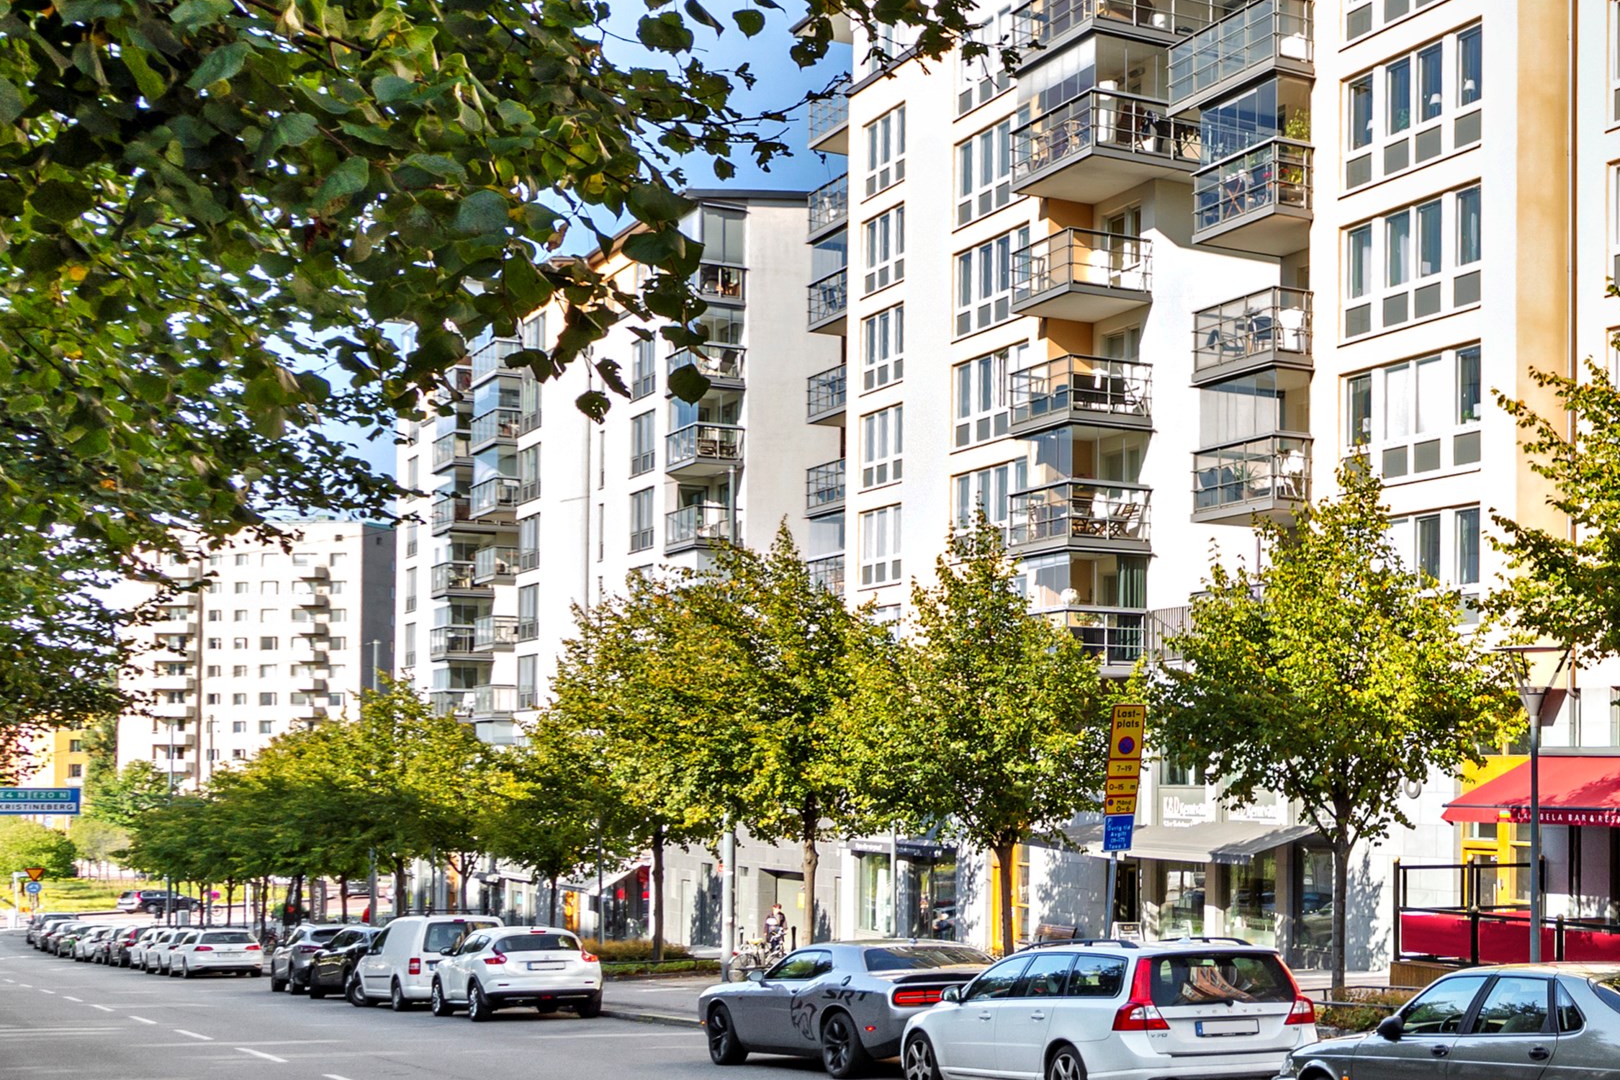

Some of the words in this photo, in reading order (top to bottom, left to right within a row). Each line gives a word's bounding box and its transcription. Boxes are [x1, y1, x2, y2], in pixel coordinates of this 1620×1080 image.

[1117, 710, 1141, 718] Last-
[1117, 720, 1140, 729] plats
[1517, 811, 1563, 821] LABELA
[1568, 813, 1586, 822] BAR
[822, 989, 874, 1006] SRT
